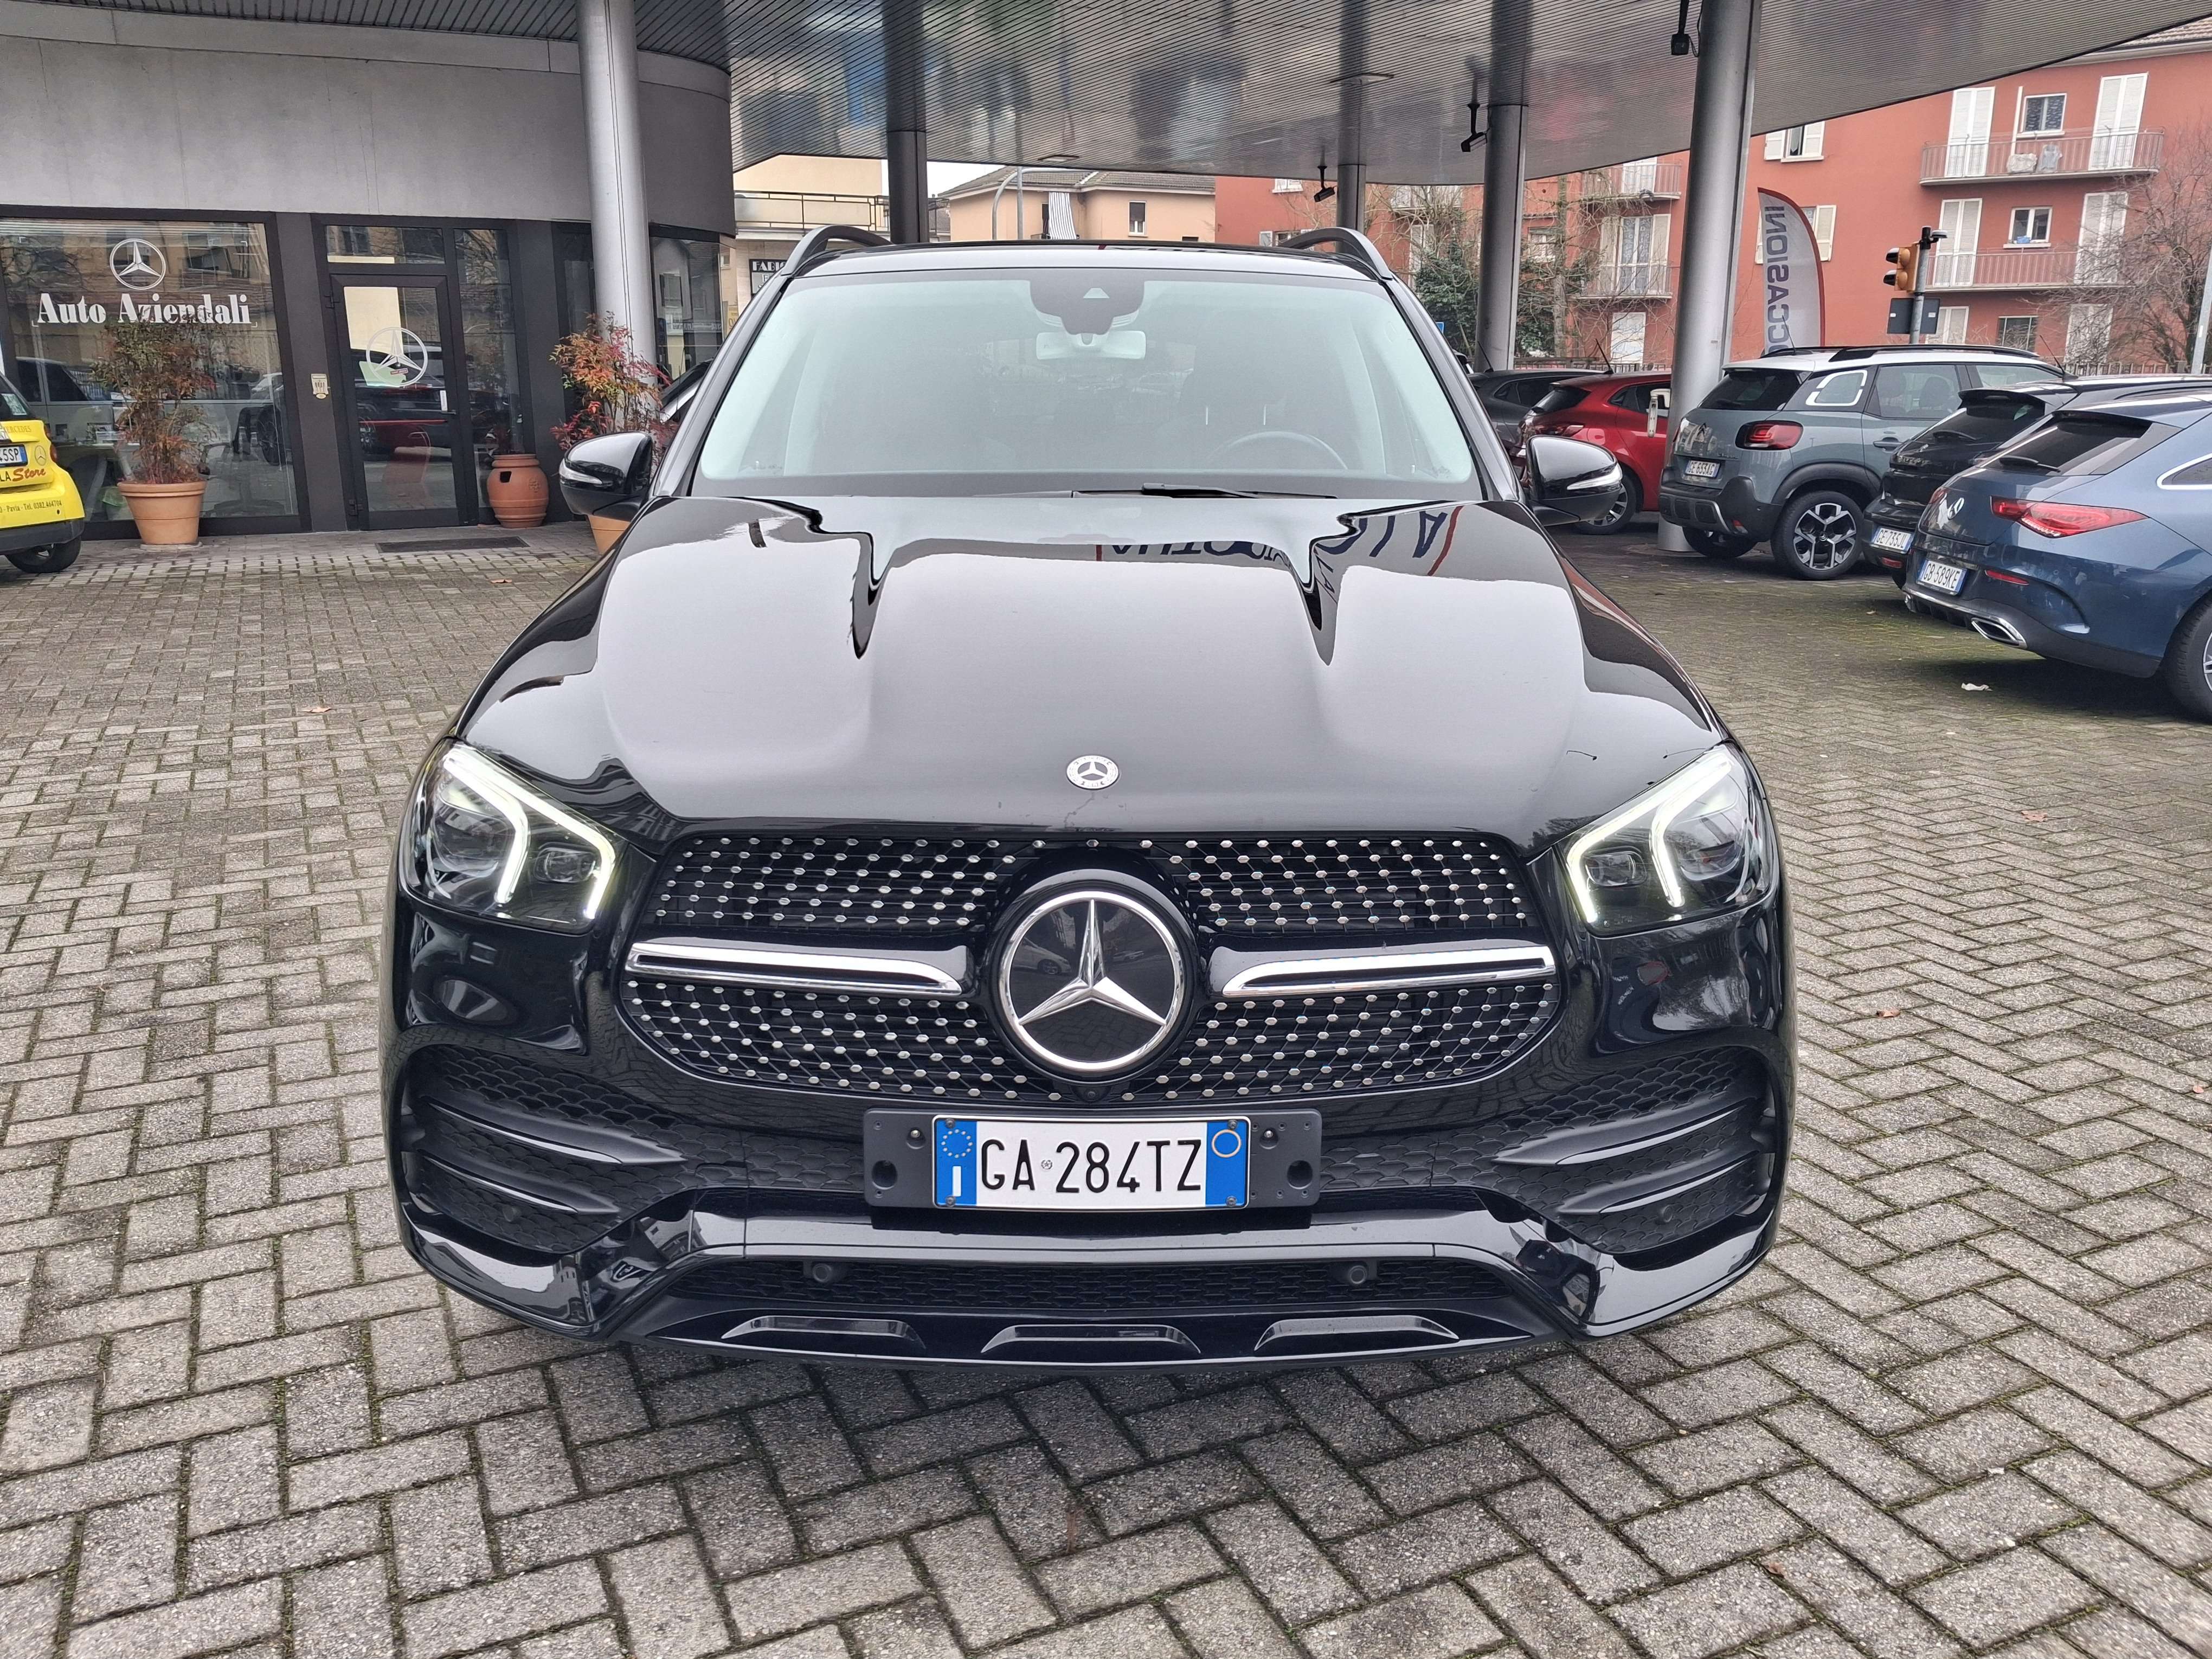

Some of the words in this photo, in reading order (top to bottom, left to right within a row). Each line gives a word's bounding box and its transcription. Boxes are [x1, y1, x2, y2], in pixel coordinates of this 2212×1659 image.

[37, 293, 106, 324] Auto
[117, 293, 252, 324] Aziendali
[12, 468, 46, 482] Store
[1924, 563, 1935, 581] GB
[1934, 566, 1960, 589] 589KE
[981, 1139, 1035, 1191] GA
[1056, 1139, 1201, 1193] 284TZ
